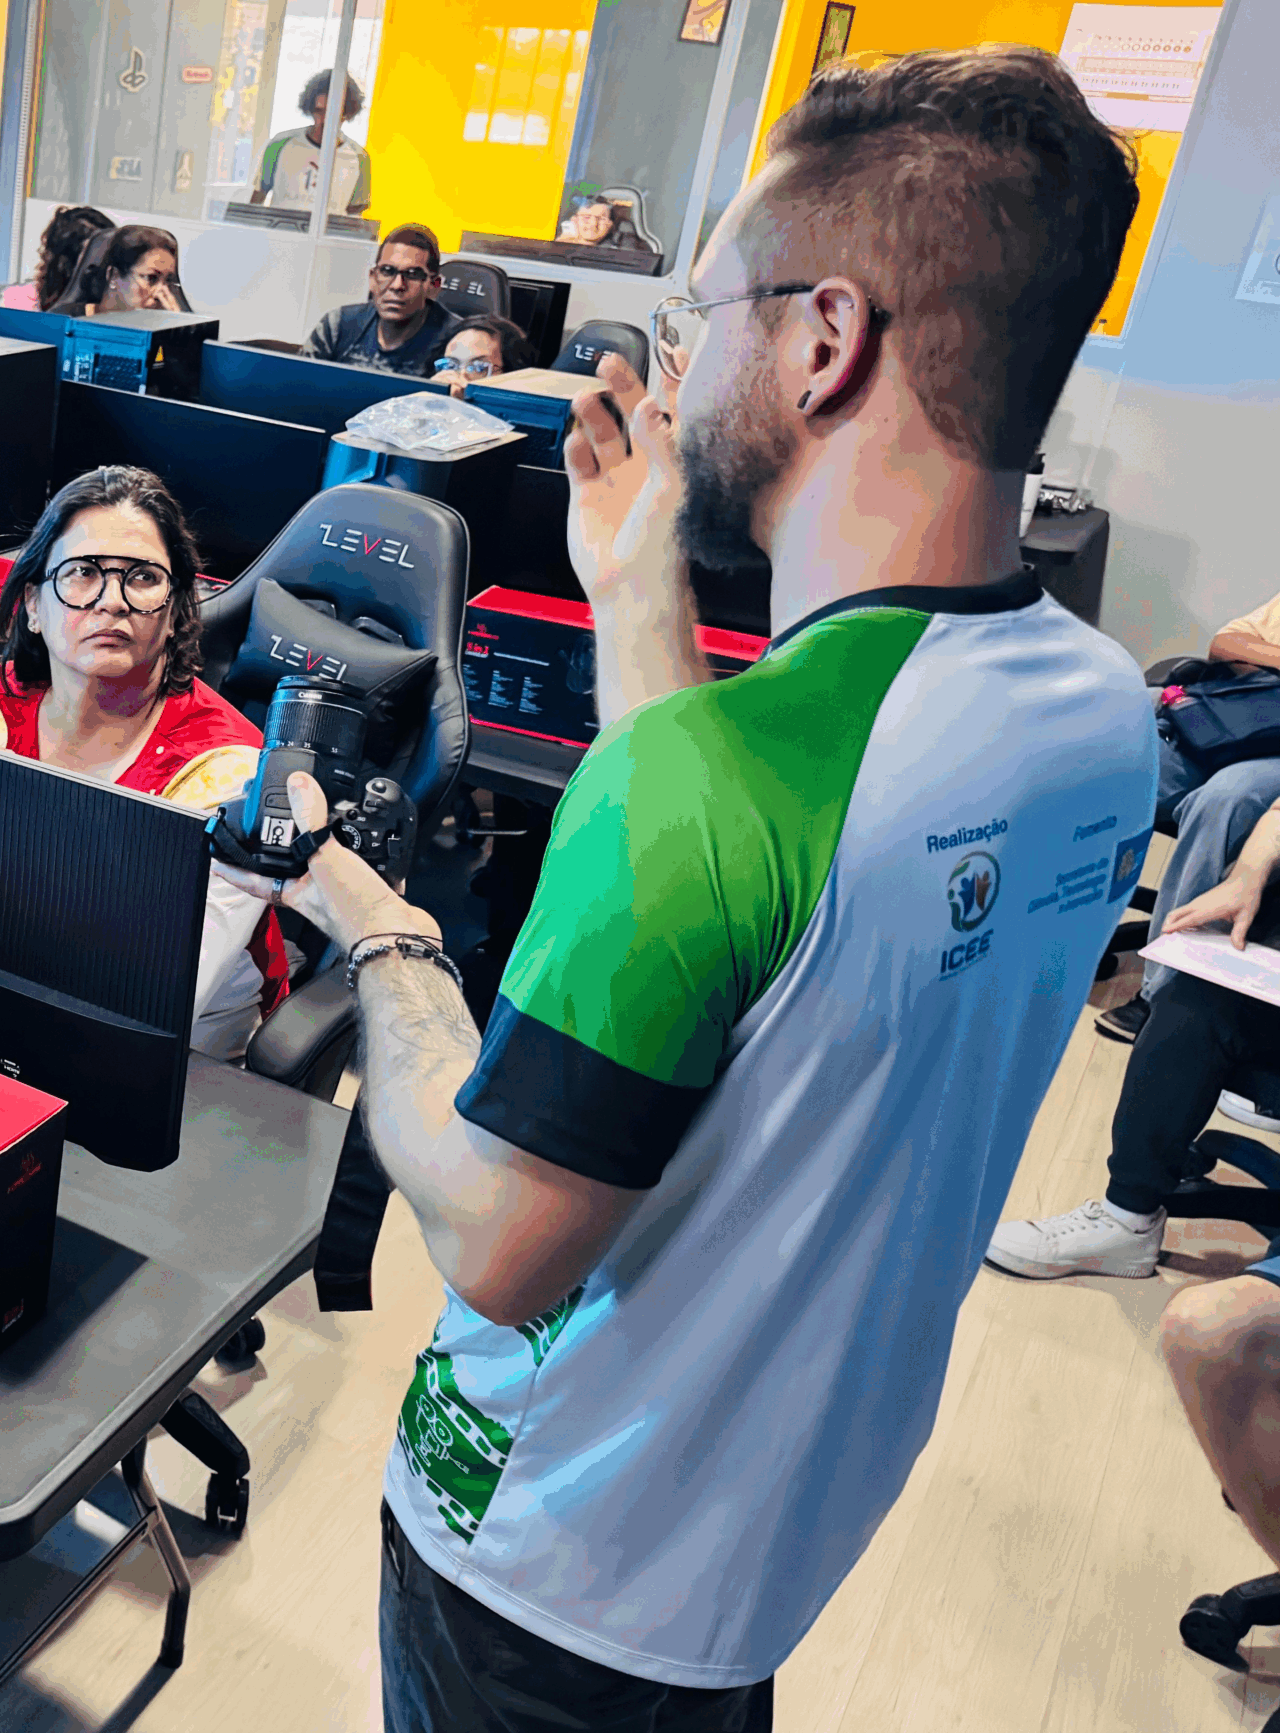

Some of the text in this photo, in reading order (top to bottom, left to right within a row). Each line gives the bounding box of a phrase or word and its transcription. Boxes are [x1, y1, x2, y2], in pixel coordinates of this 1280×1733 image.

[298, 691, 323, 700] Canon
[926, 817, 1009, 854] Realização
[939, 928, 995, 974] ICEE
